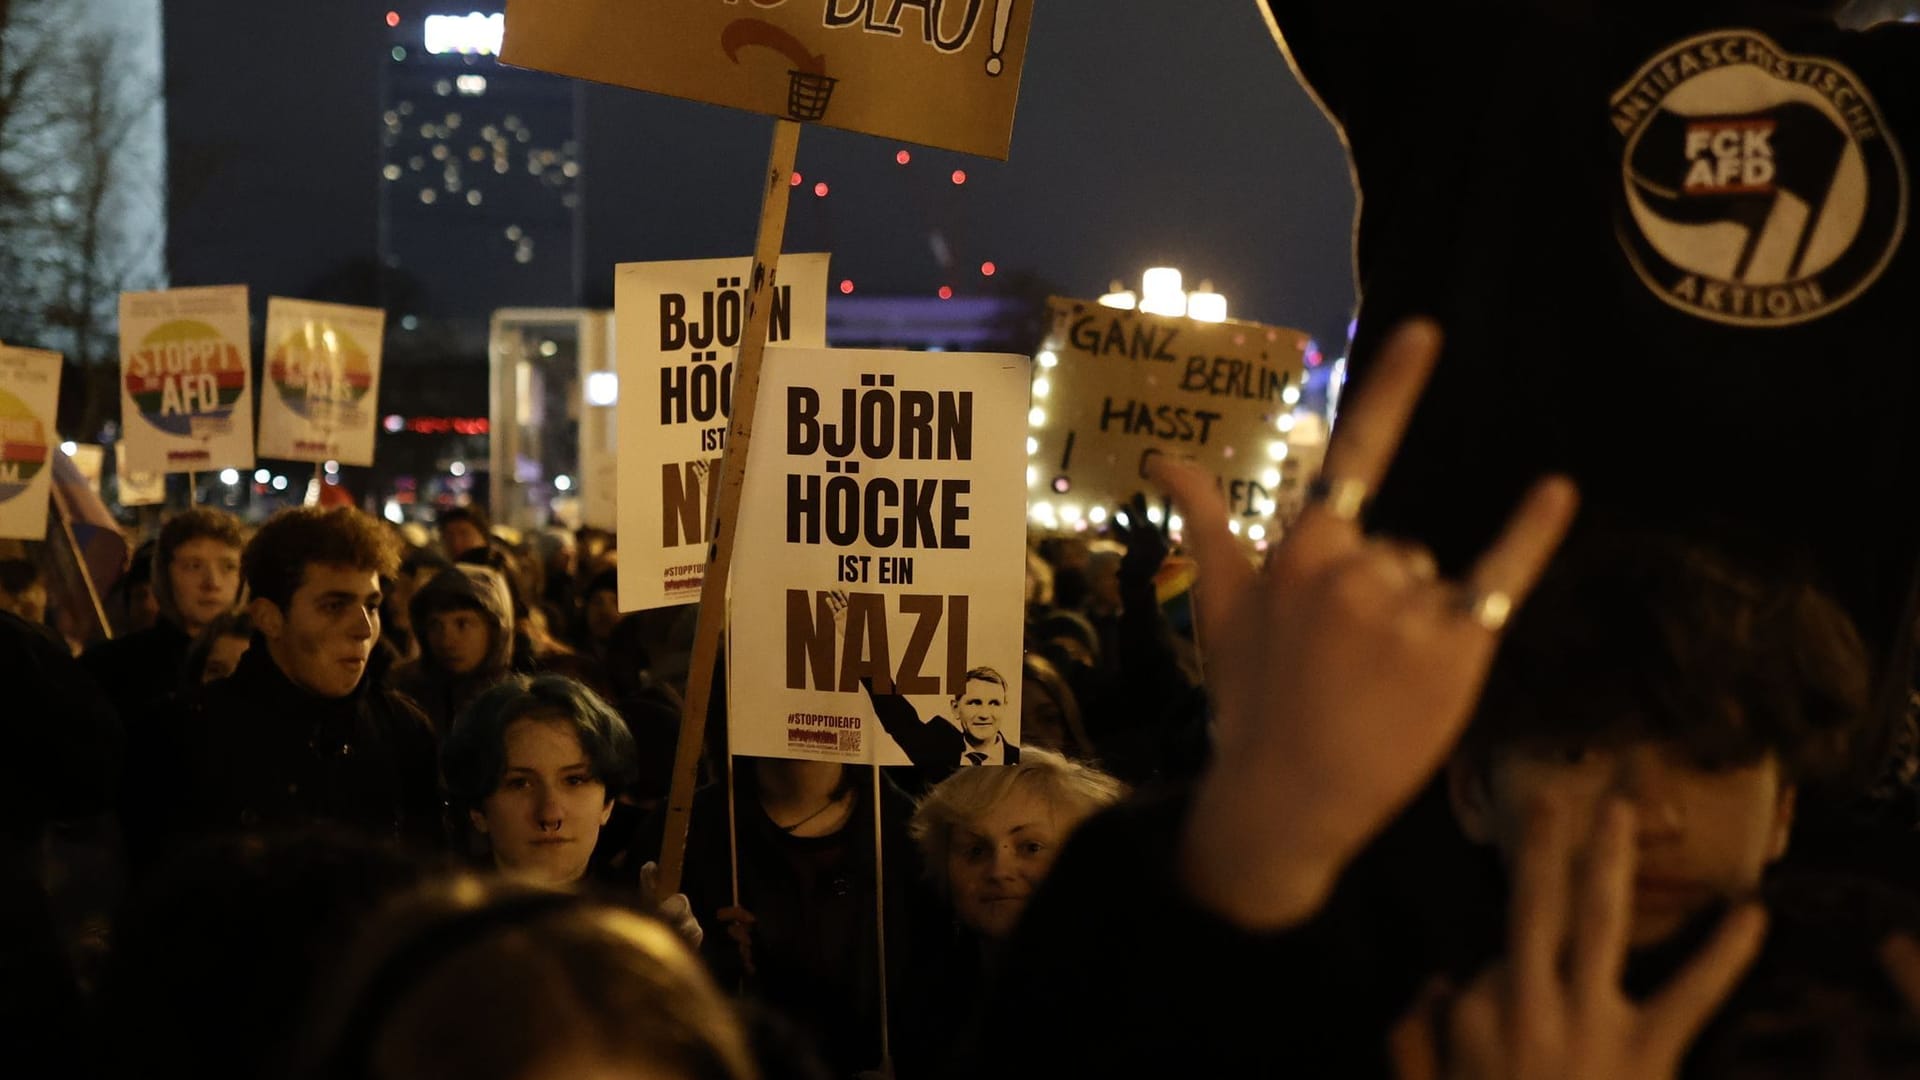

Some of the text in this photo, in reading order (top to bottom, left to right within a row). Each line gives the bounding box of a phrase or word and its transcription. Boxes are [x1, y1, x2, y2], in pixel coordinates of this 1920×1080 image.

[1684, 129, 1776, 160] FCK
[1682, 159, 1777, 187] AFD
[660, 277, 790, 351] BJÖN
[1673, 273, 1827, 316] AKTION
[130, 339, 231, 378] STOPPT
[1070, 315, 1179, 362] GANZ
[161, 372, 219, 417] AFD
[787, 373, 973, 461] BJÖRN
[1100, 397, 1221, 445] HASST
[702, 427, 726, 452] IST
[786, 460, 970, 550] HÖCKE
[838, 555, 913, 584] IST EIN
[786, 589, 969, 695] NAZI
[787, 713, 861, 729] #STOPPTDIEAFD
